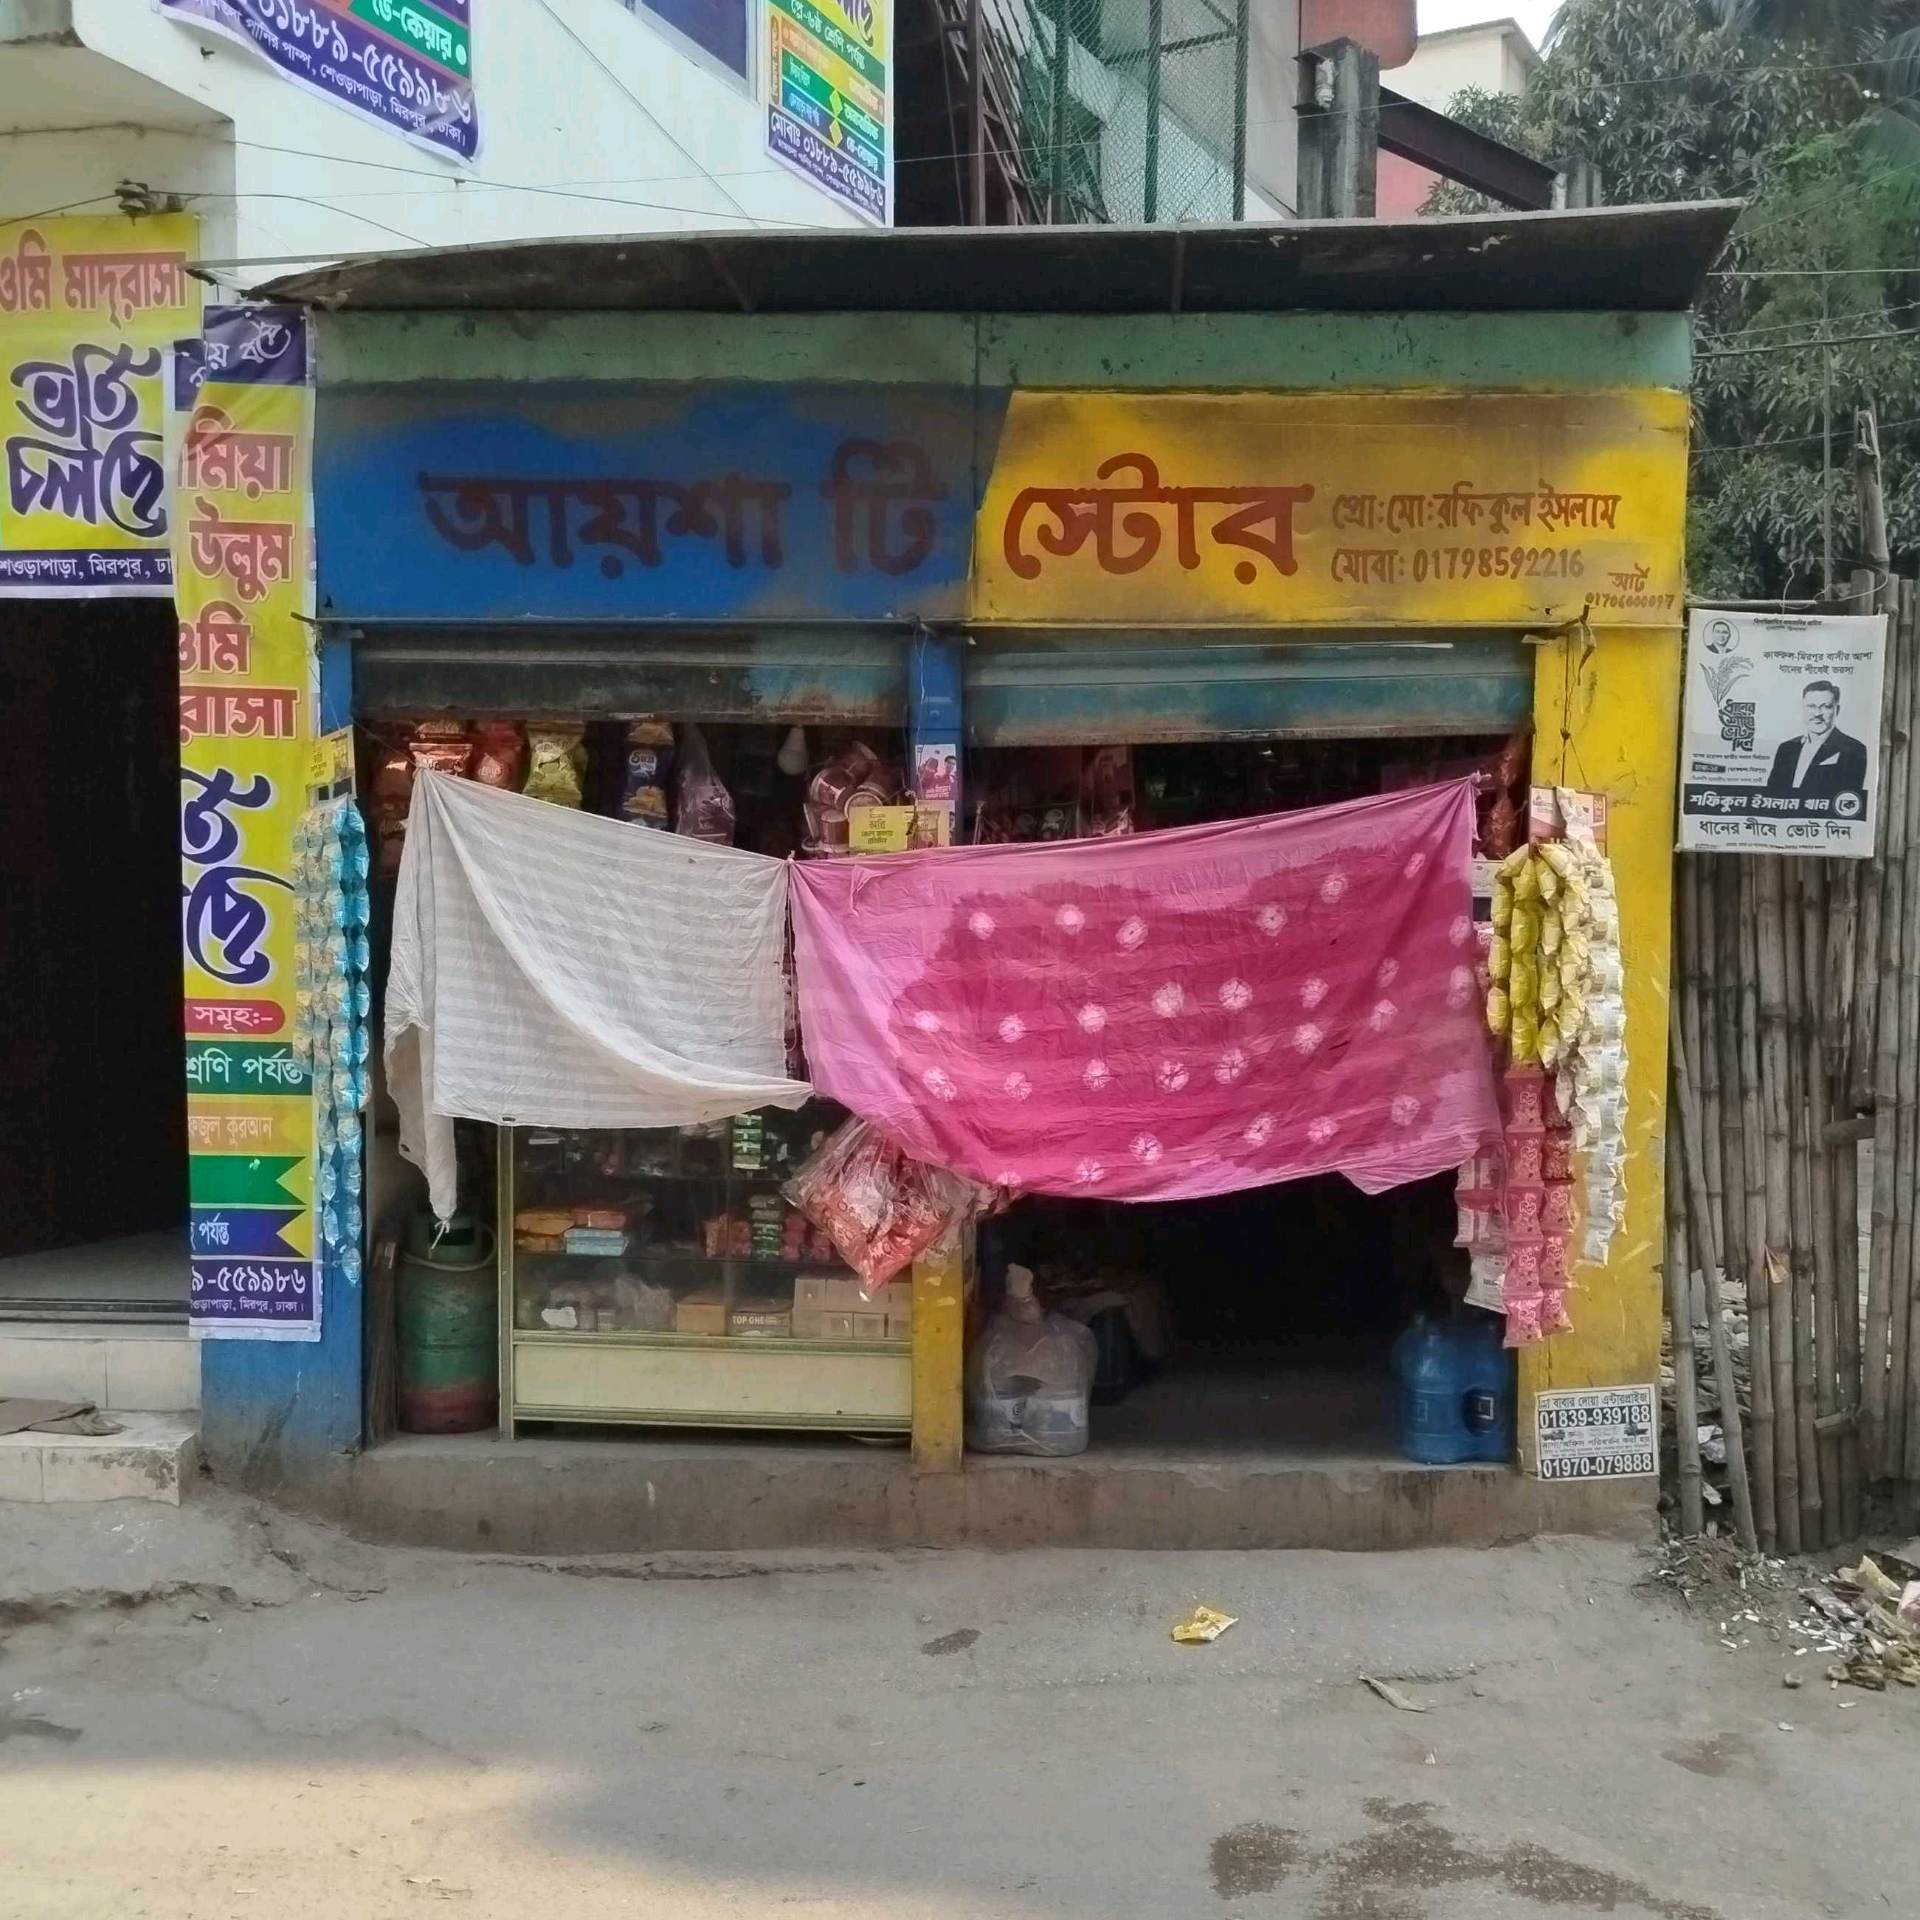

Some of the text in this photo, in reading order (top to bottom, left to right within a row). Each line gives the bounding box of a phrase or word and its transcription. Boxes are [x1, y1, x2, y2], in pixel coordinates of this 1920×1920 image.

[820, 437, 943, 577] টি
[1003, 452, 1315, 585] স্টোর
[188, 495, 295, 602] উলুম
[1412, 546, 1586, 583] 01798592216
[1699, 820, 1741, 836] ধানের
[1786, 819, 1822, 839] ভোট
[1825, 820, 1853, 840] দিন
[1539, 1405, 1651, 1429] 01839-939188
[1542, 1453, 1653, 1478] 01970-079888
